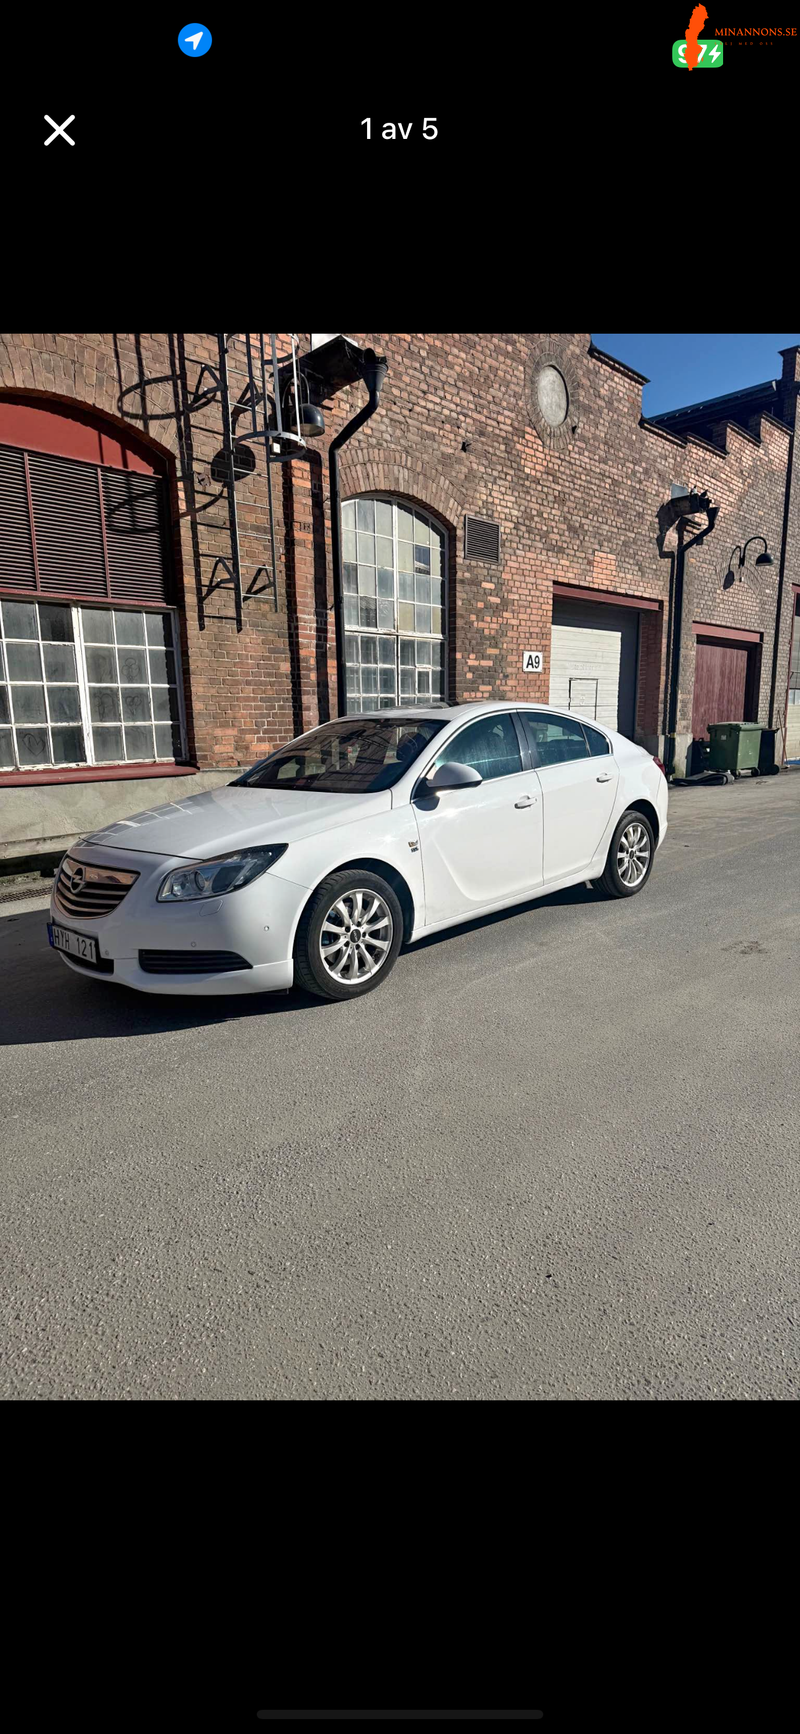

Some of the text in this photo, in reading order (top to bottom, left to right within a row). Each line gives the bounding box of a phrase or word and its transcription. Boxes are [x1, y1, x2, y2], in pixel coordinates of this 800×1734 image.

[360, 117, 439, 140] 1 av 5
[525, 654, 541, 670] A9
[53, 928, 94, 960] HYH 121
